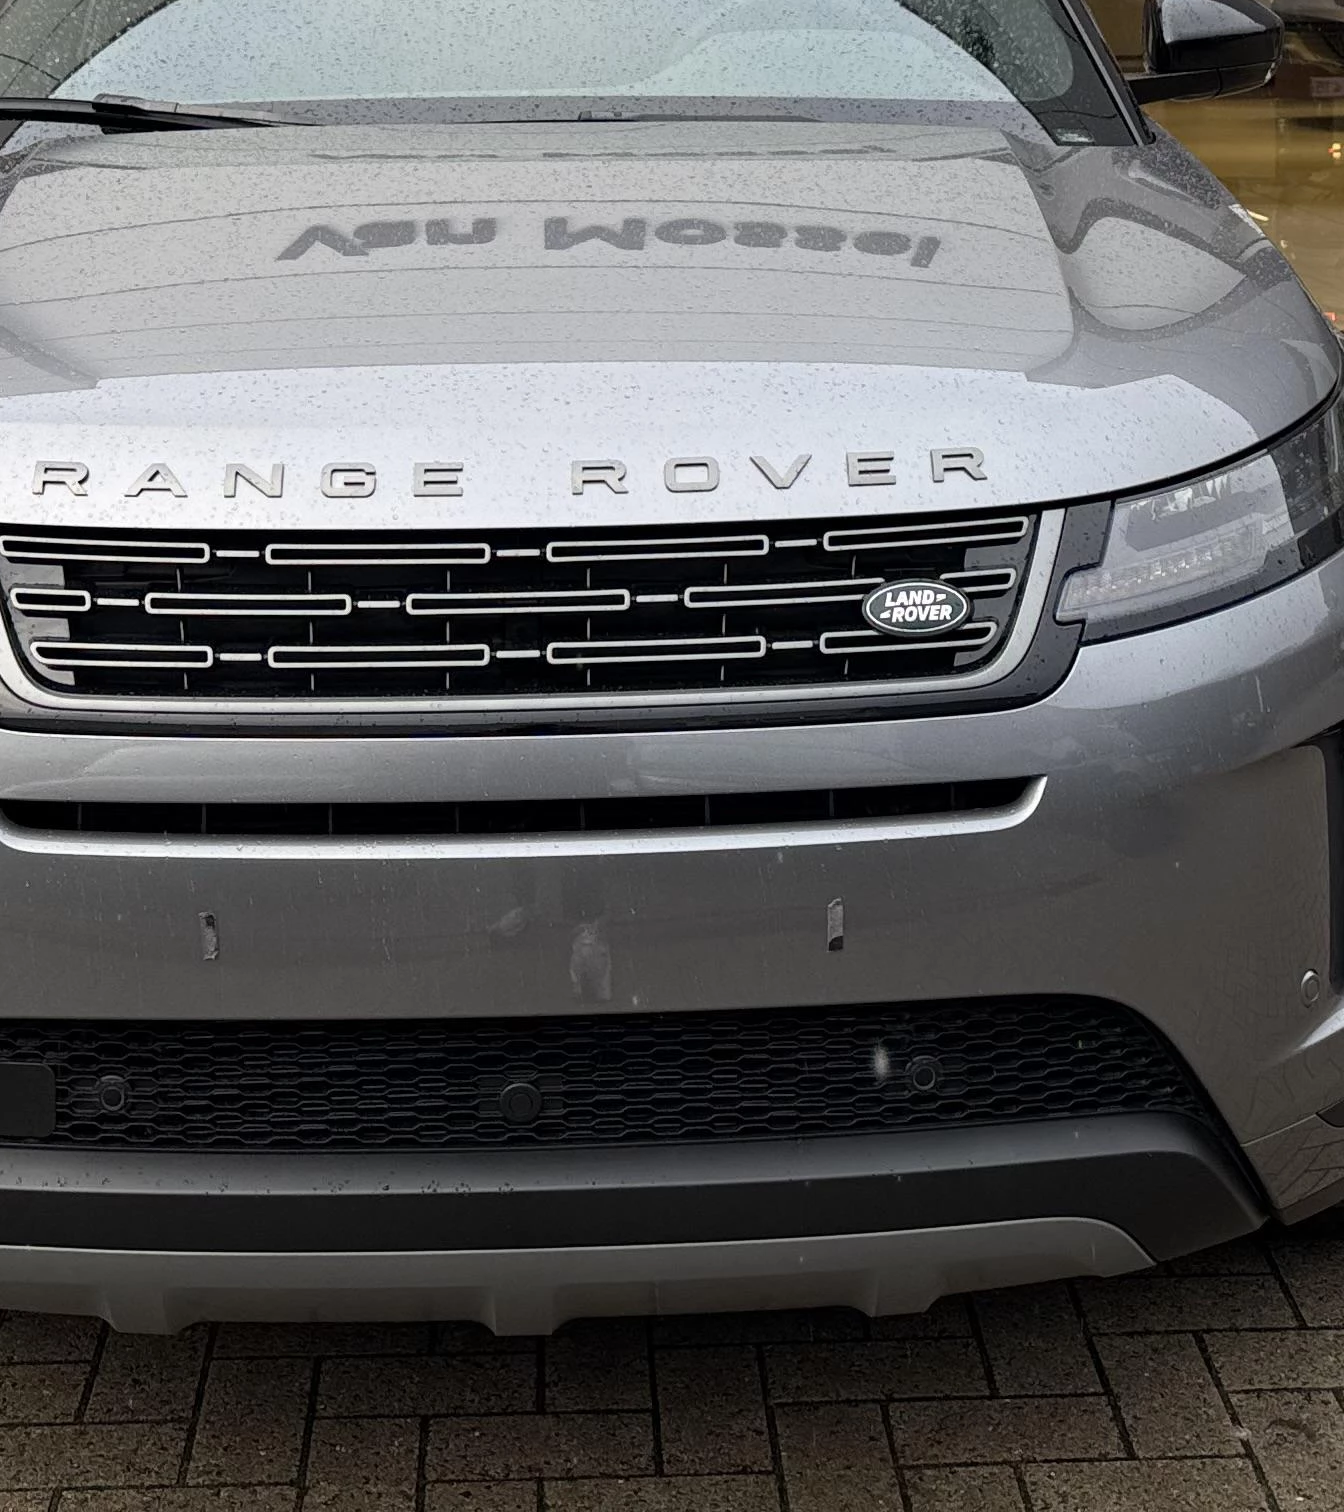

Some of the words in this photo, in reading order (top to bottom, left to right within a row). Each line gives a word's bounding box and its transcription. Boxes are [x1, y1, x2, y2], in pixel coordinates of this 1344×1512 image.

[31, 459, 464, 500] RANGE
[571, 446, 989, 496] ROVER
[884, 589, 935, 608] LAND
[891, 604, 953, 623] ROVER
